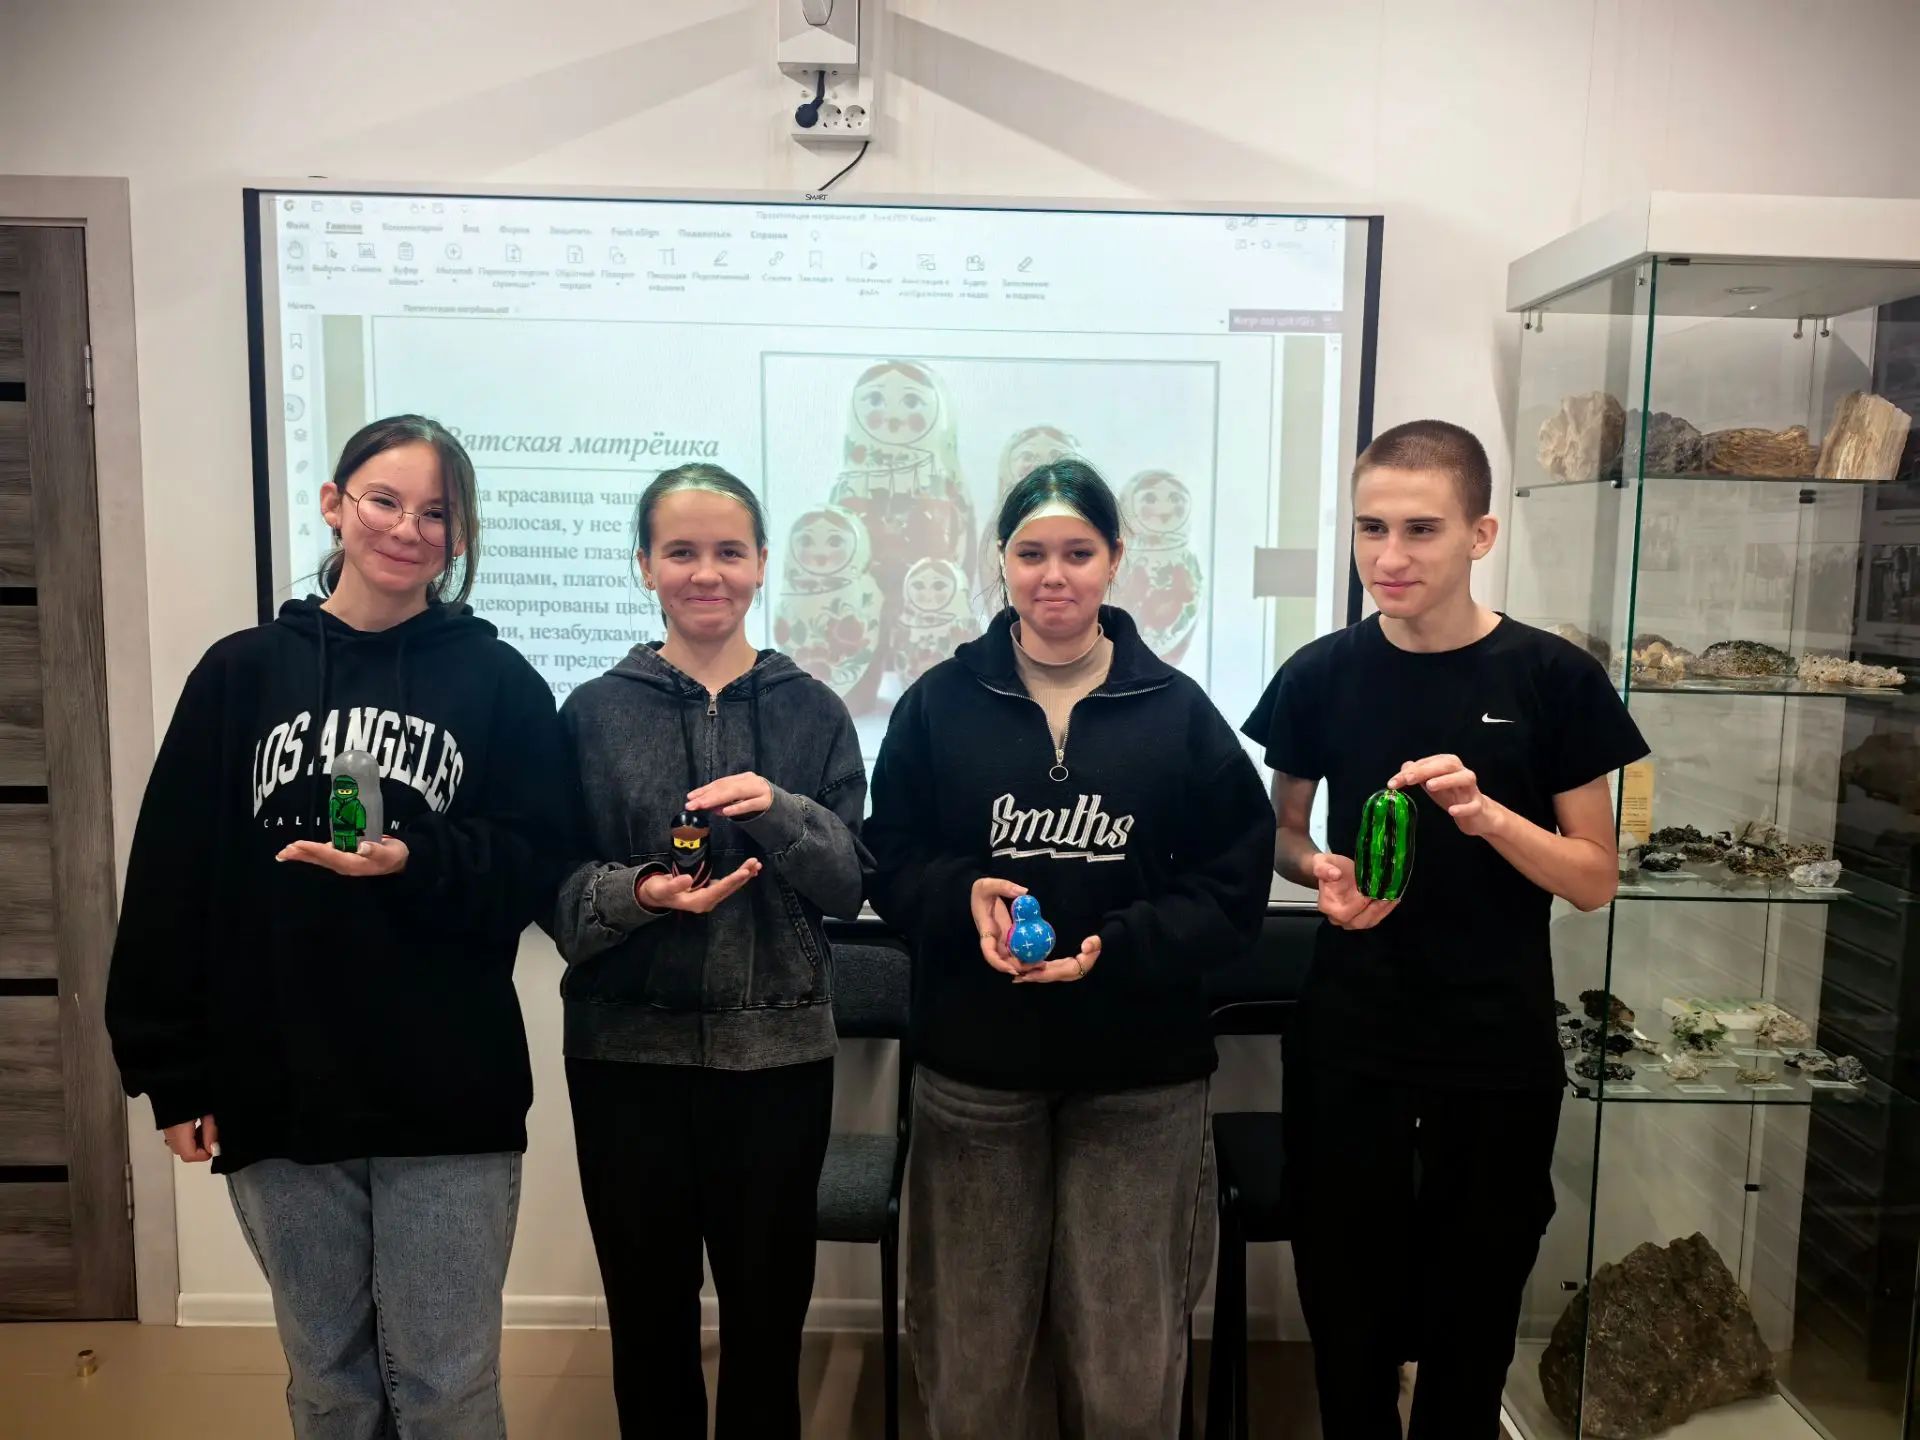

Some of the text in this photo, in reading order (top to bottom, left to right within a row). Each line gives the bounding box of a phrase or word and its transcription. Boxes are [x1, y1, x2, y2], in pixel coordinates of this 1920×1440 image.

[805, 193, 828, 201] SMART
[569, 431, 719, 462] матрёшка
[498, 489, 594, 508] красавица
[573, 519, 584, 536] у
[590, 519, 622, 533] нее
[584, 547, 632, 561] глаза
[563, 573, 628, 589] платок
[475, 598, 660, 617] декорированы цвет
[530, 624, 655, 645] незабудками,
[554, 653, 620, 671] предст
[252, 706, 464, 819] LOS ANGELES
